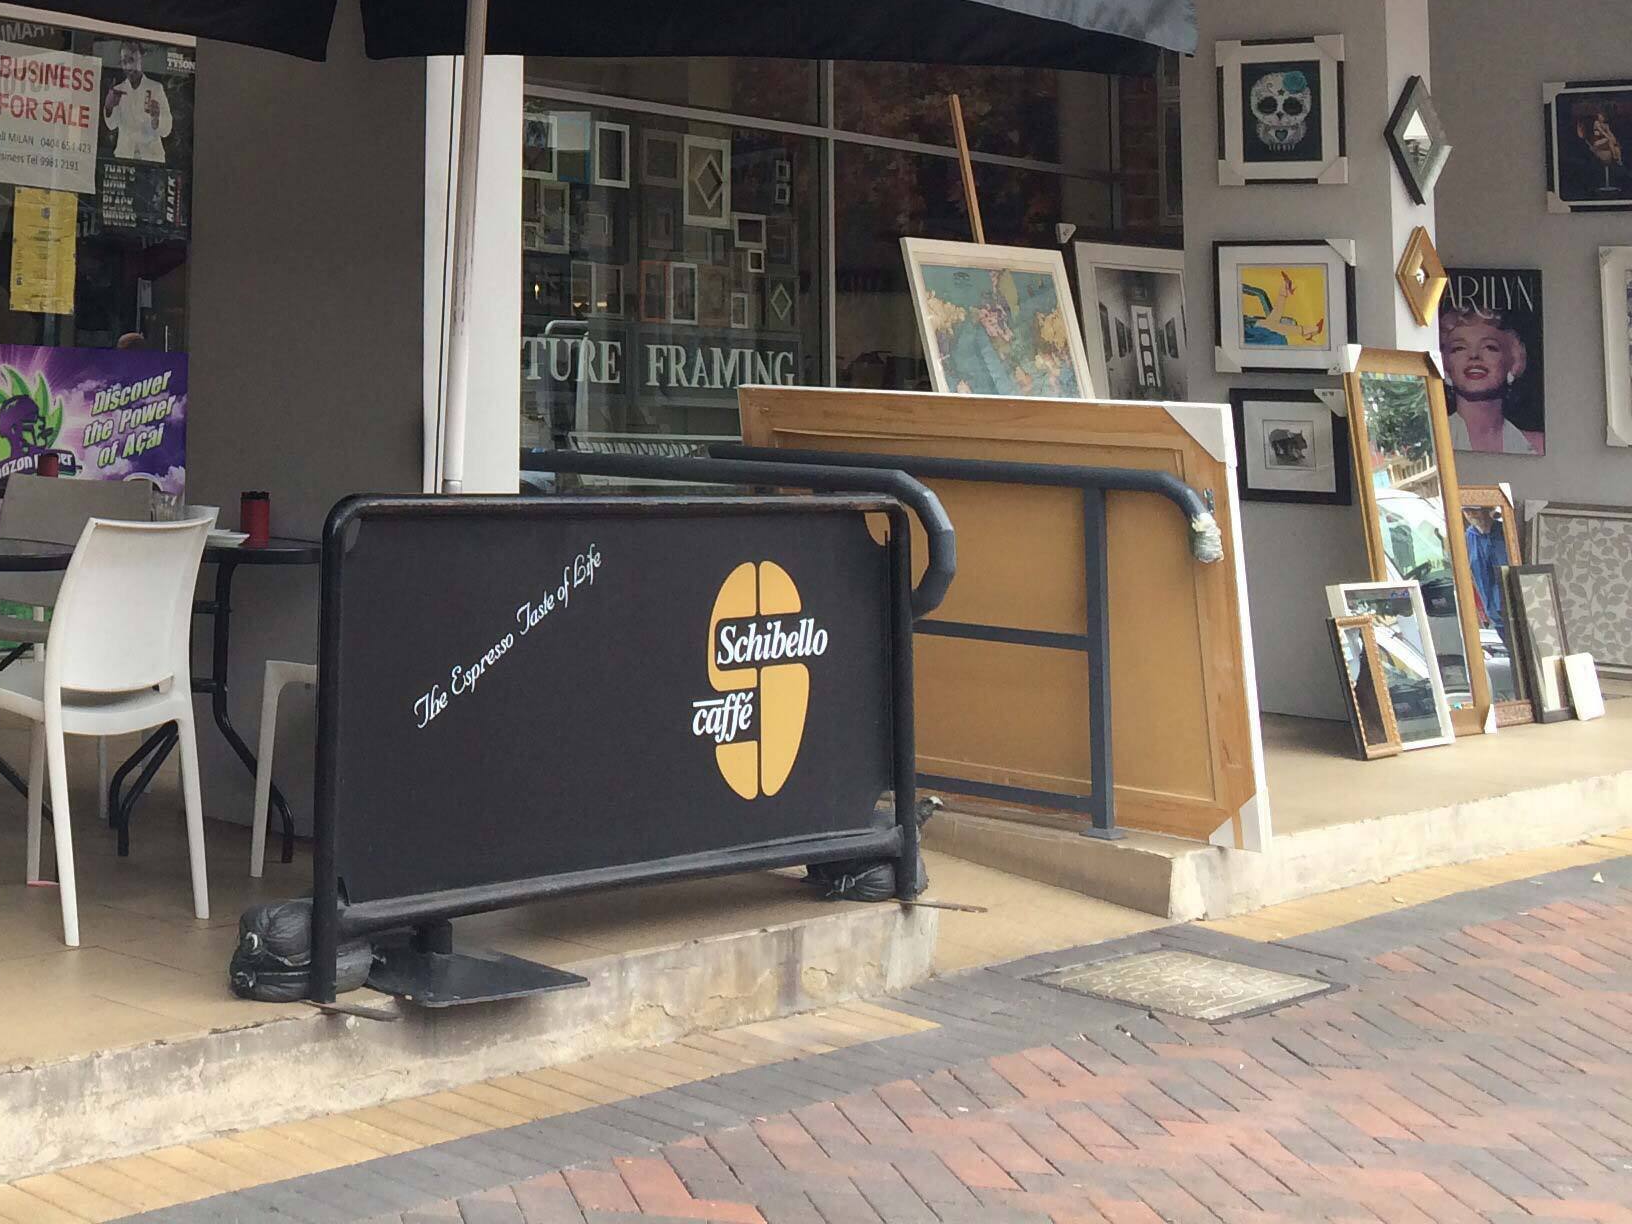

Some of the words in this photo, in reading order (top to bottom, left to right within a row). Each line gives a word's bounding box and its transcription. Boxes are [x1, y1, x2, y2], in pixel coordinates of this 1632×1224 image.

[0, 55, 95, 92] BUSINESS
[166, 58, 196, 70] TYSON
[42, 100, 91, 128] SALE
[26, 154, 38, 165] Tel
[1444, 274, 1533, 320] ARILYN
[522, 336, 622, 384] TURE
[645, 344, 794, 388] FRAMING
[91, 370, 172, 416] Discover
[83, 419, 113, 447] the
[119, 396, 177, 433] Power
[98, 442, 120, 468] of
[122, 423, 164, 456] Açai
[413, 683, 448, 729] The
[451, 631, 514, 695] Espresso
[516, 590, 554, 635] Taste
[556, 566, 570, 608] of
[572, 543, 601, 587] Life
[716, 618, 828, 664] Schibello
[693, 691, 753, 742] caffé
